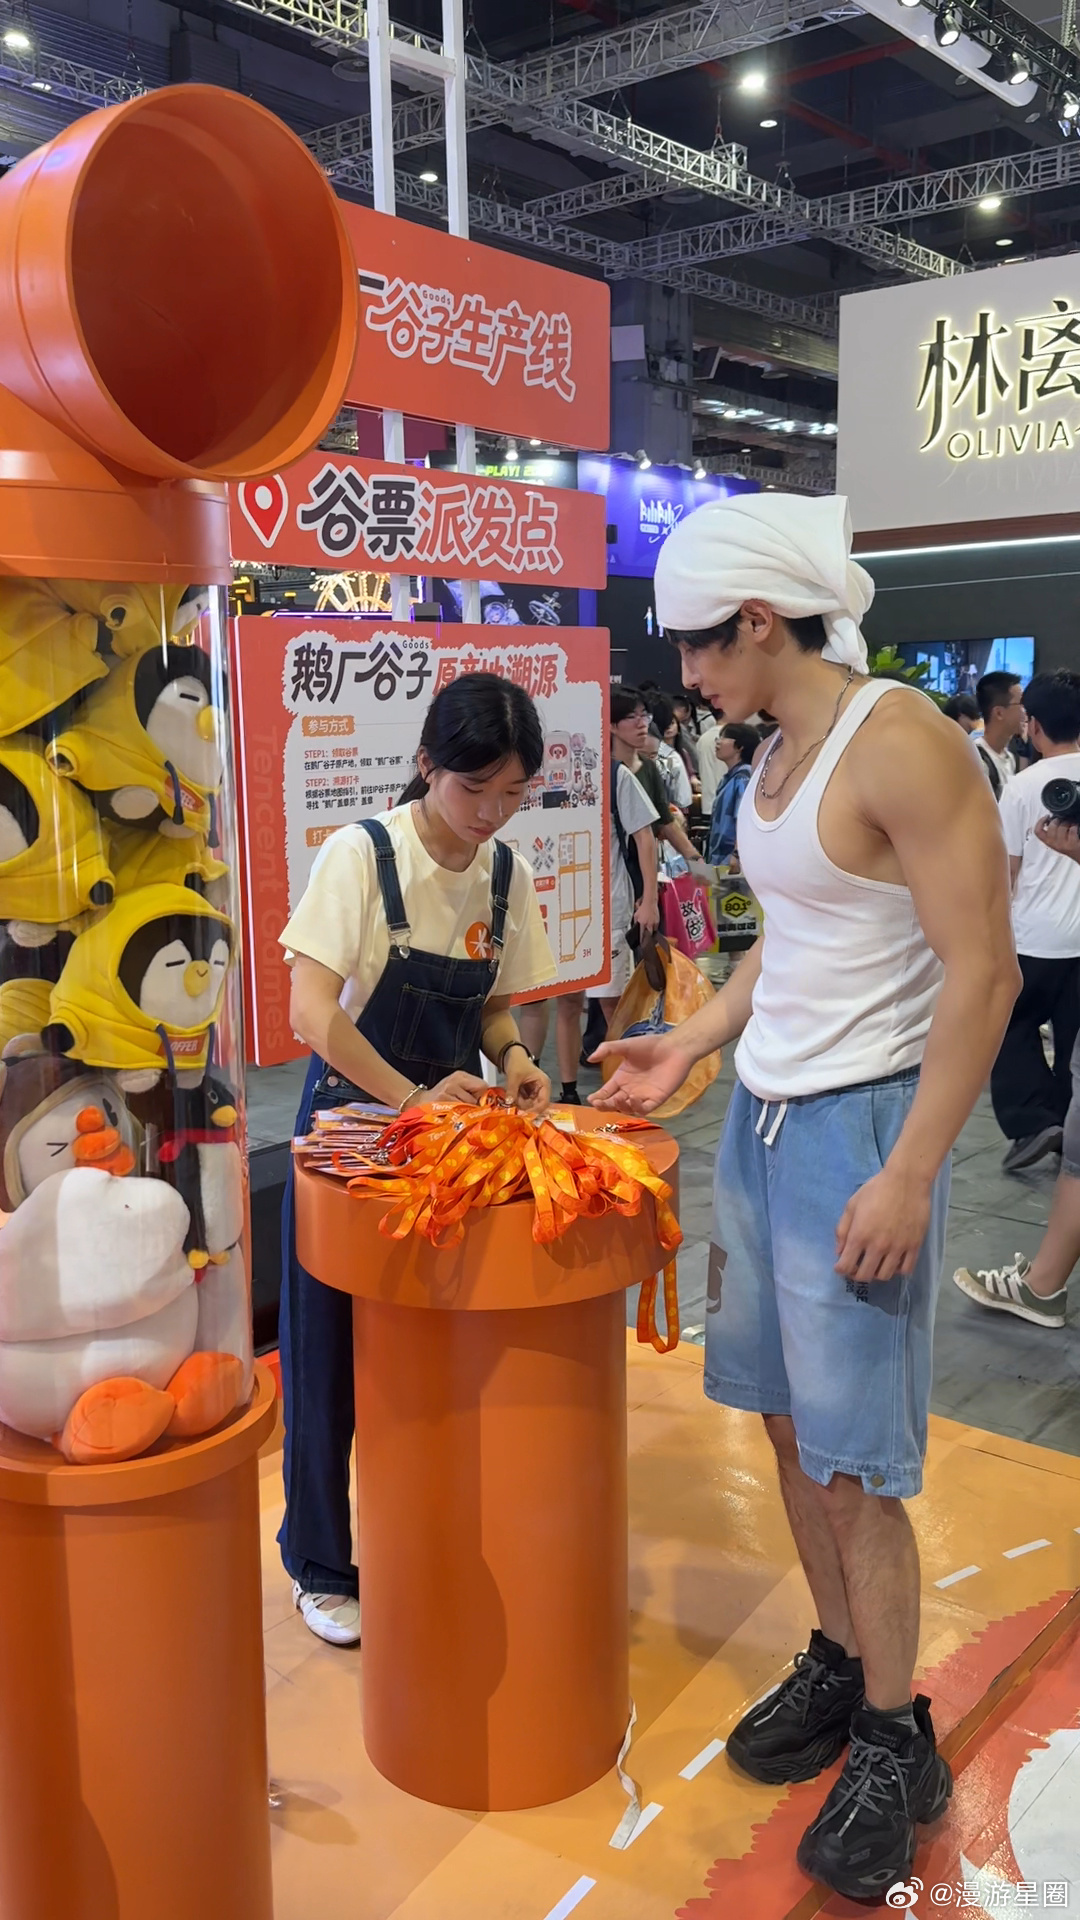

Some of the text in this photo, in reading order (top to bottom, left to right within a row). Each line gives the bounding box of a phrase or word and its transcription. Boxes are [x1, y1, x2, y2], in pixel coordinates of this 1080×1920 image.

[422, 289, 452, 305] Goods
[359, 270, 576, 402] 谷子生产线
[946, 420, 1071, 459] OLIVIA
[298, 463, 564, 574] 谷票派发点
[402, 640, 430, 650] Goods
[308, 719, 350, 734] 参与方式
[252, 725, 286, 1050] Tencent Games
[582, 948, 592, 958] 3H
[170, 1040, 199, 1052] OFFER
[431, 1103, 453, 1111] Tenc
